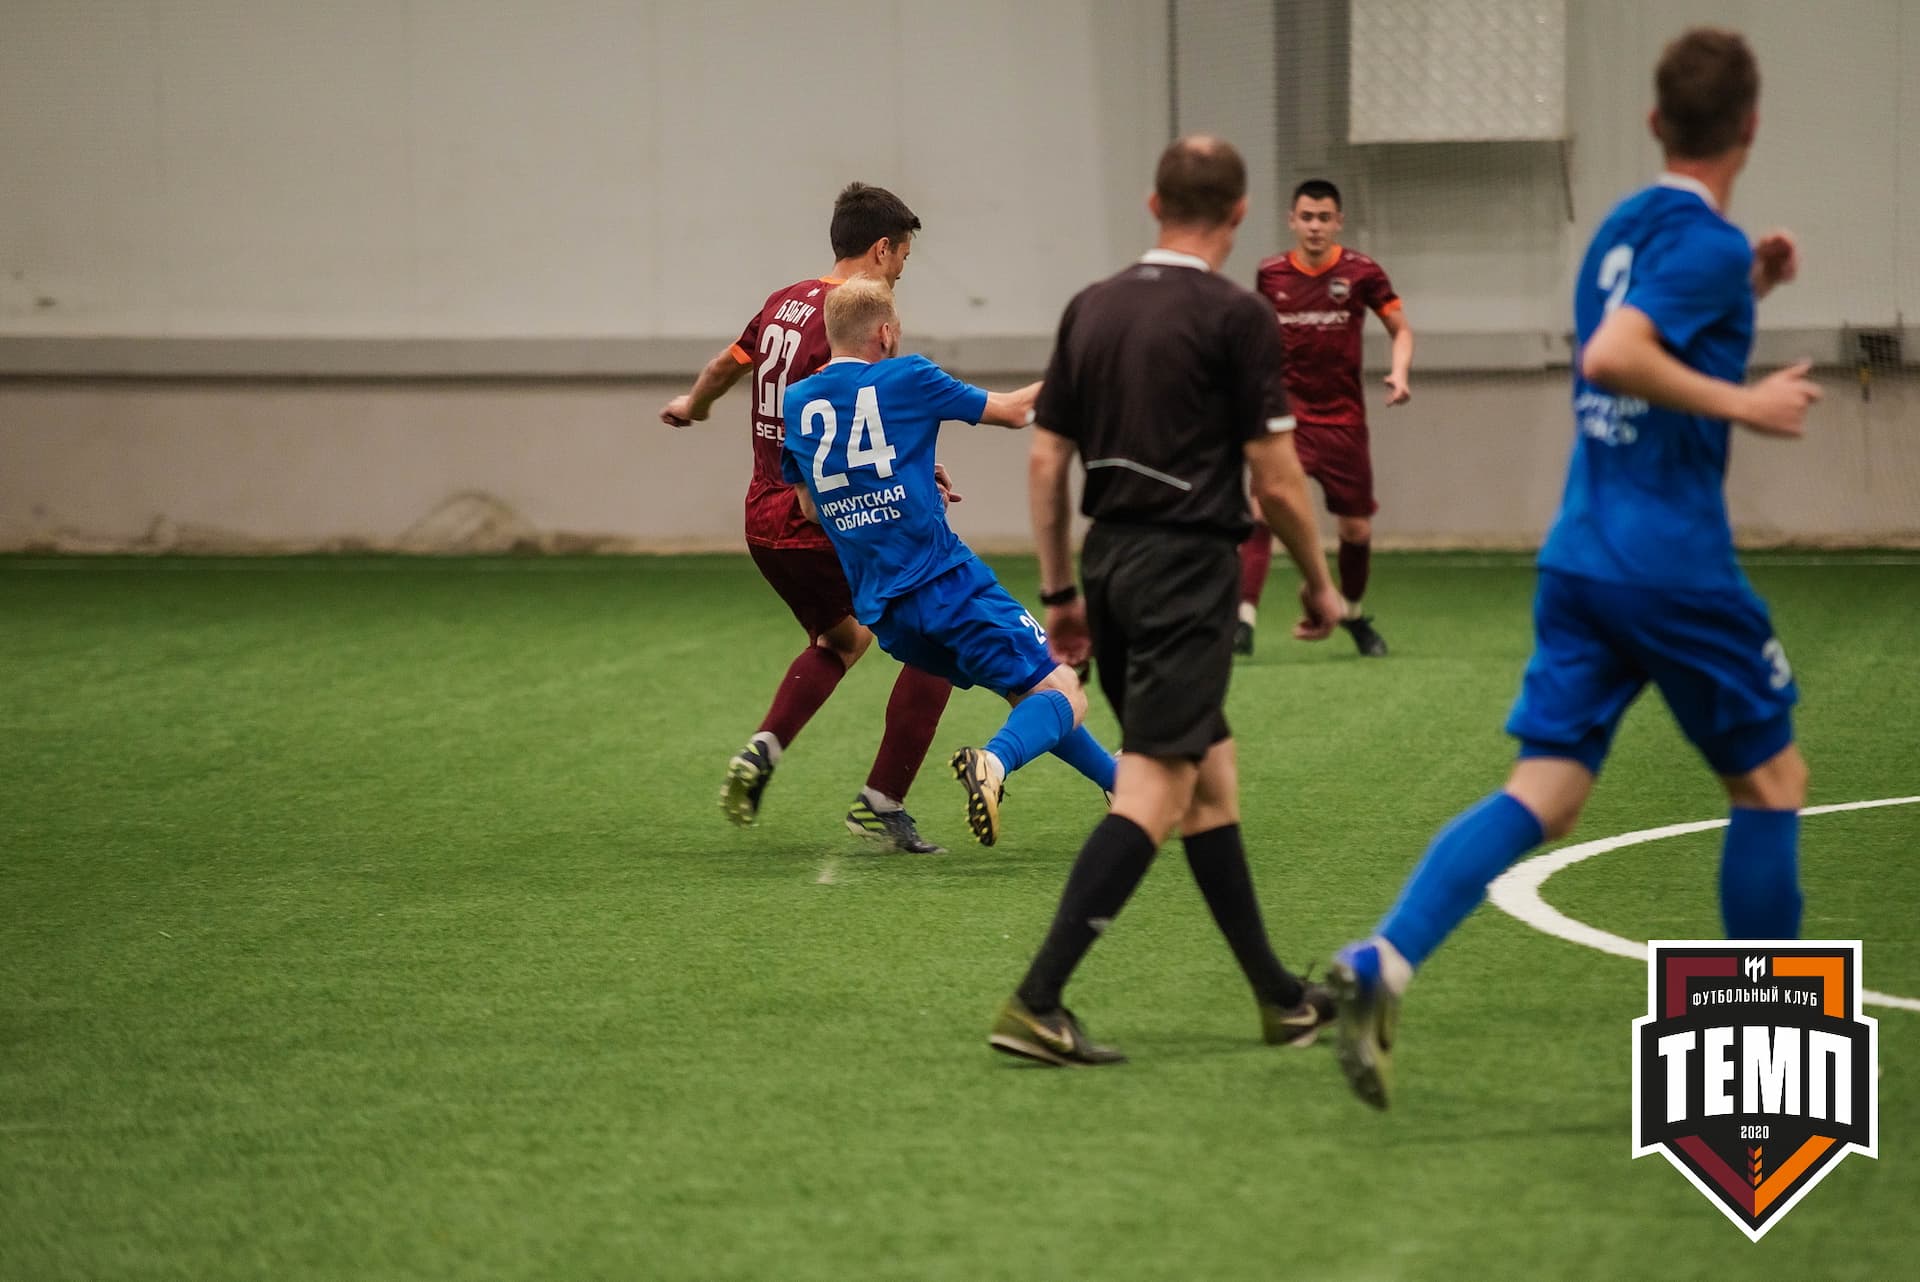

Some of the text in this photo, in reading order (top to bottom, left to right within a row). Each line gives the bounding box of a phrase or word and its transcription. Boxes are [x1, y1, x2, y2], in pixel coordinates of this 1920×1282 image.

[801, 385, 897, 493] 24
[820, 485, 906, 517] ИРКУТСКАЯ
[835, 505, 902, 531] ОБЛАСТЬ
[1761, 637, 1792, 691] 3
